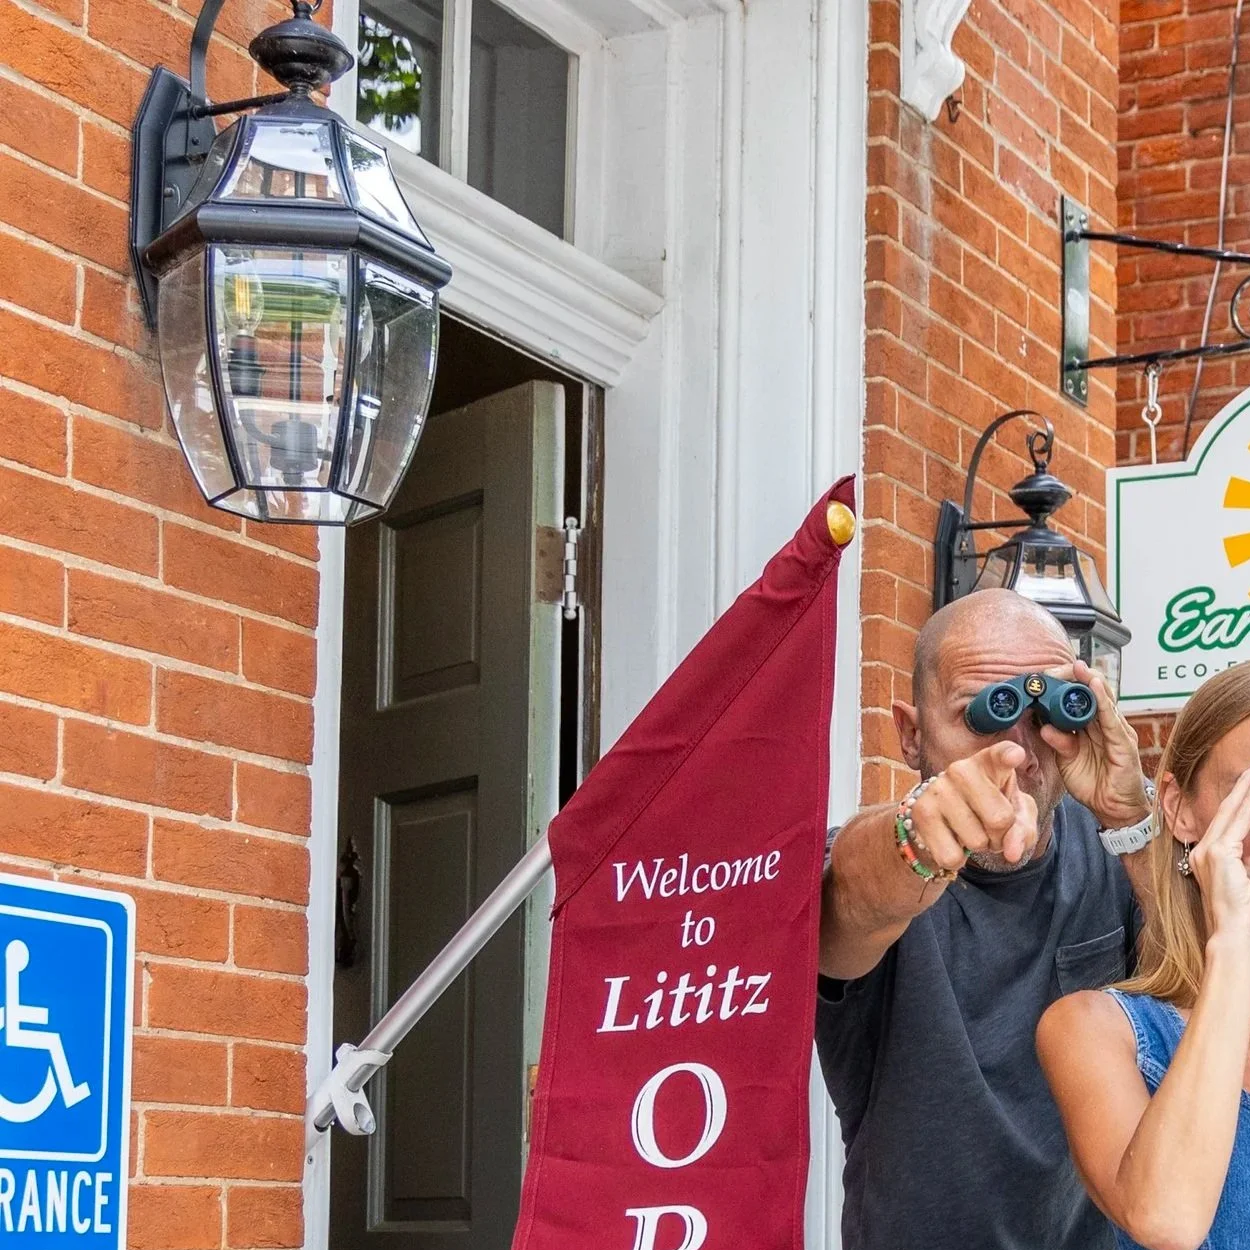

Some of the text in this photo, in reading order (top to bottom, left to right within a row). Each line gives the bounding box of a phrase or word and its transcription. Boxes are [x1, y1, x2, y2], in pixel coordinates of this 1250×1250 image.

[612, 849, 782, 902] Welcome
[680, 910, 716, 949] to
[596, 964, 773, 1034] Lititz
[0, 1167, 112, 1234] RANCE
